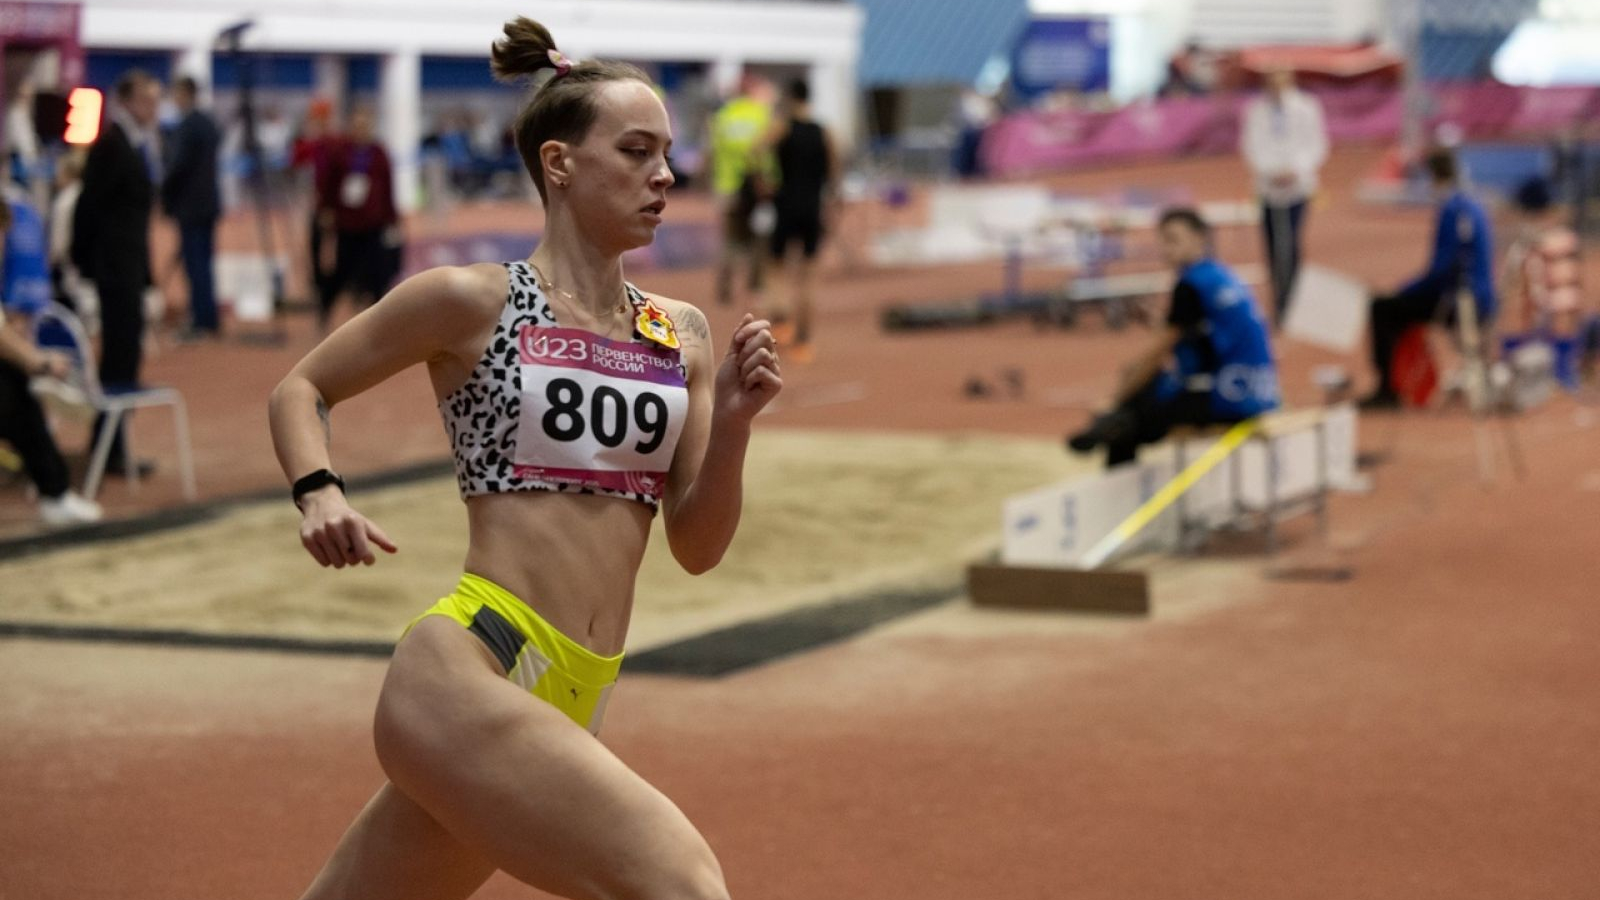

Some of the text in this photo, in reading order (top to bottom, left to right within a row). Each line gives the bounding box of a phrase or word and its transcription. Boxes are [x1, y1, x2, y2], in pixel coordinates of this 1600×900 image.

[528, 337, 588, 360] U23
[592, 343, 672, 369] ПЕРВЕНСТВО
[592, 354, 645, 373] РОССИИ
[542, 378, 668, 454] 809
